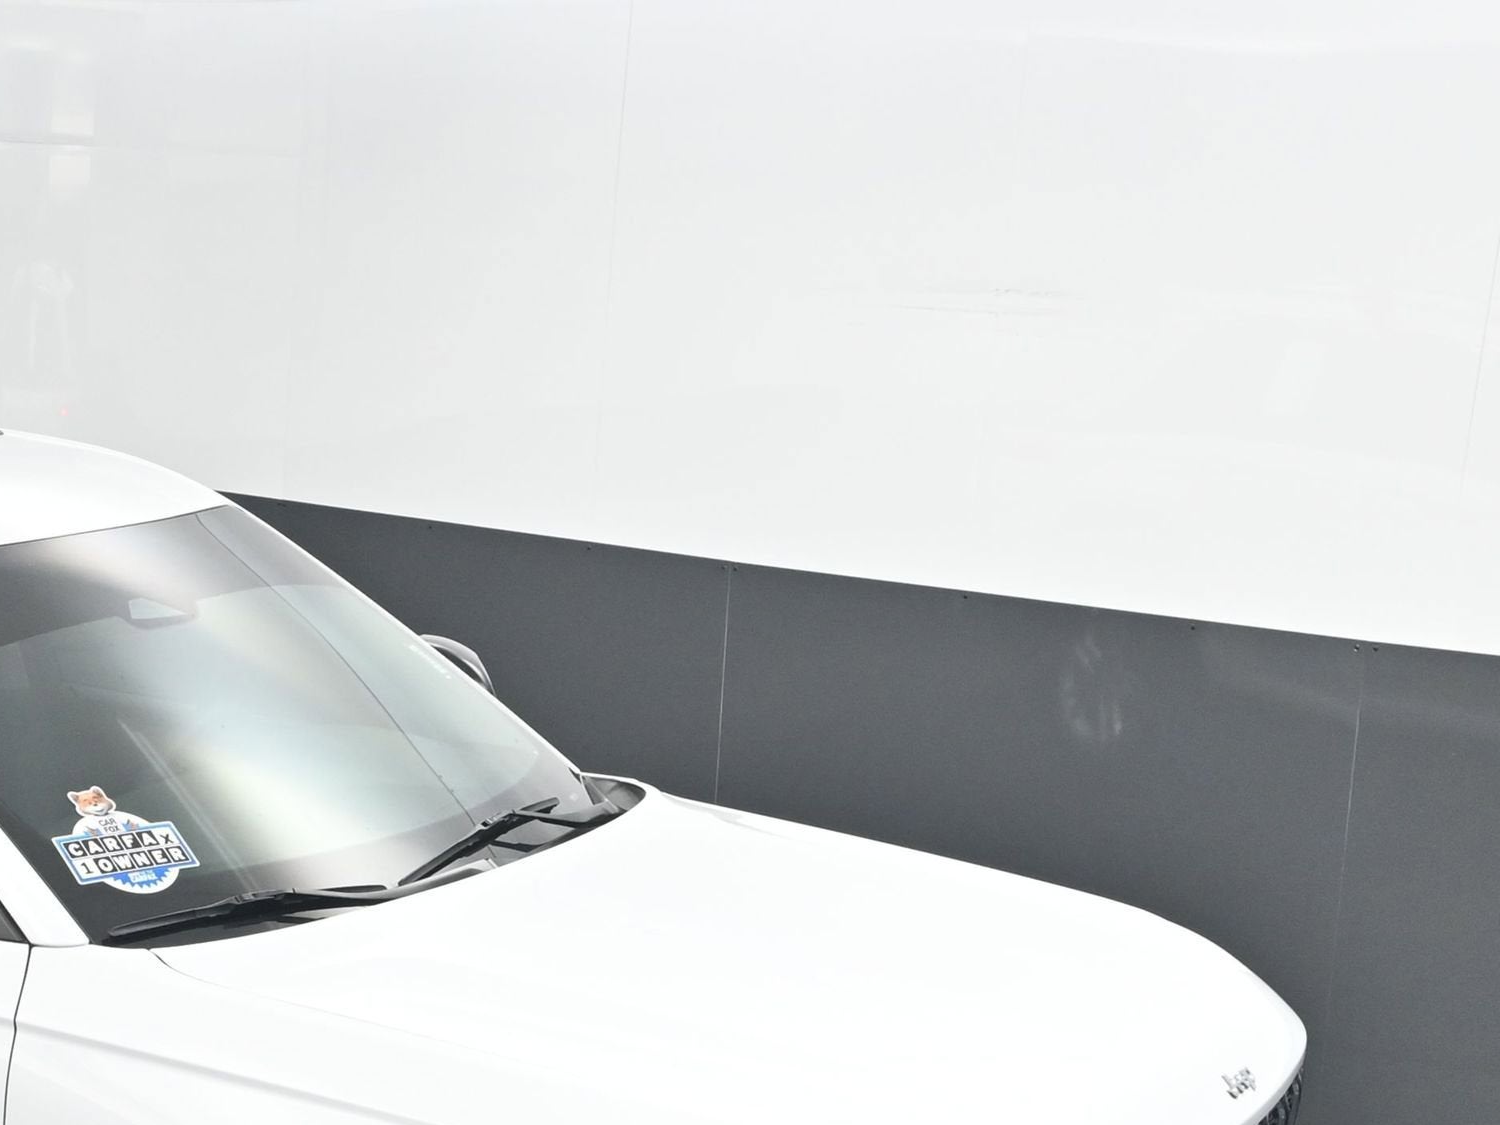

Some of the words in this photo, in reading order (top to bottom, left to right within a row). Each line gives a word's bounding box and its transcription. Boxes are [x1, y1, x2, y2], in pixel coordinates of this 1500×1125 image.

[98, 817, 117, 827] CAR
[103, 825, 120, 833] FOX
[66, 830, 175, 858] CARFAX
[80, 859, 95, 875] 1
[97, 847, 189, 873] OWNER
